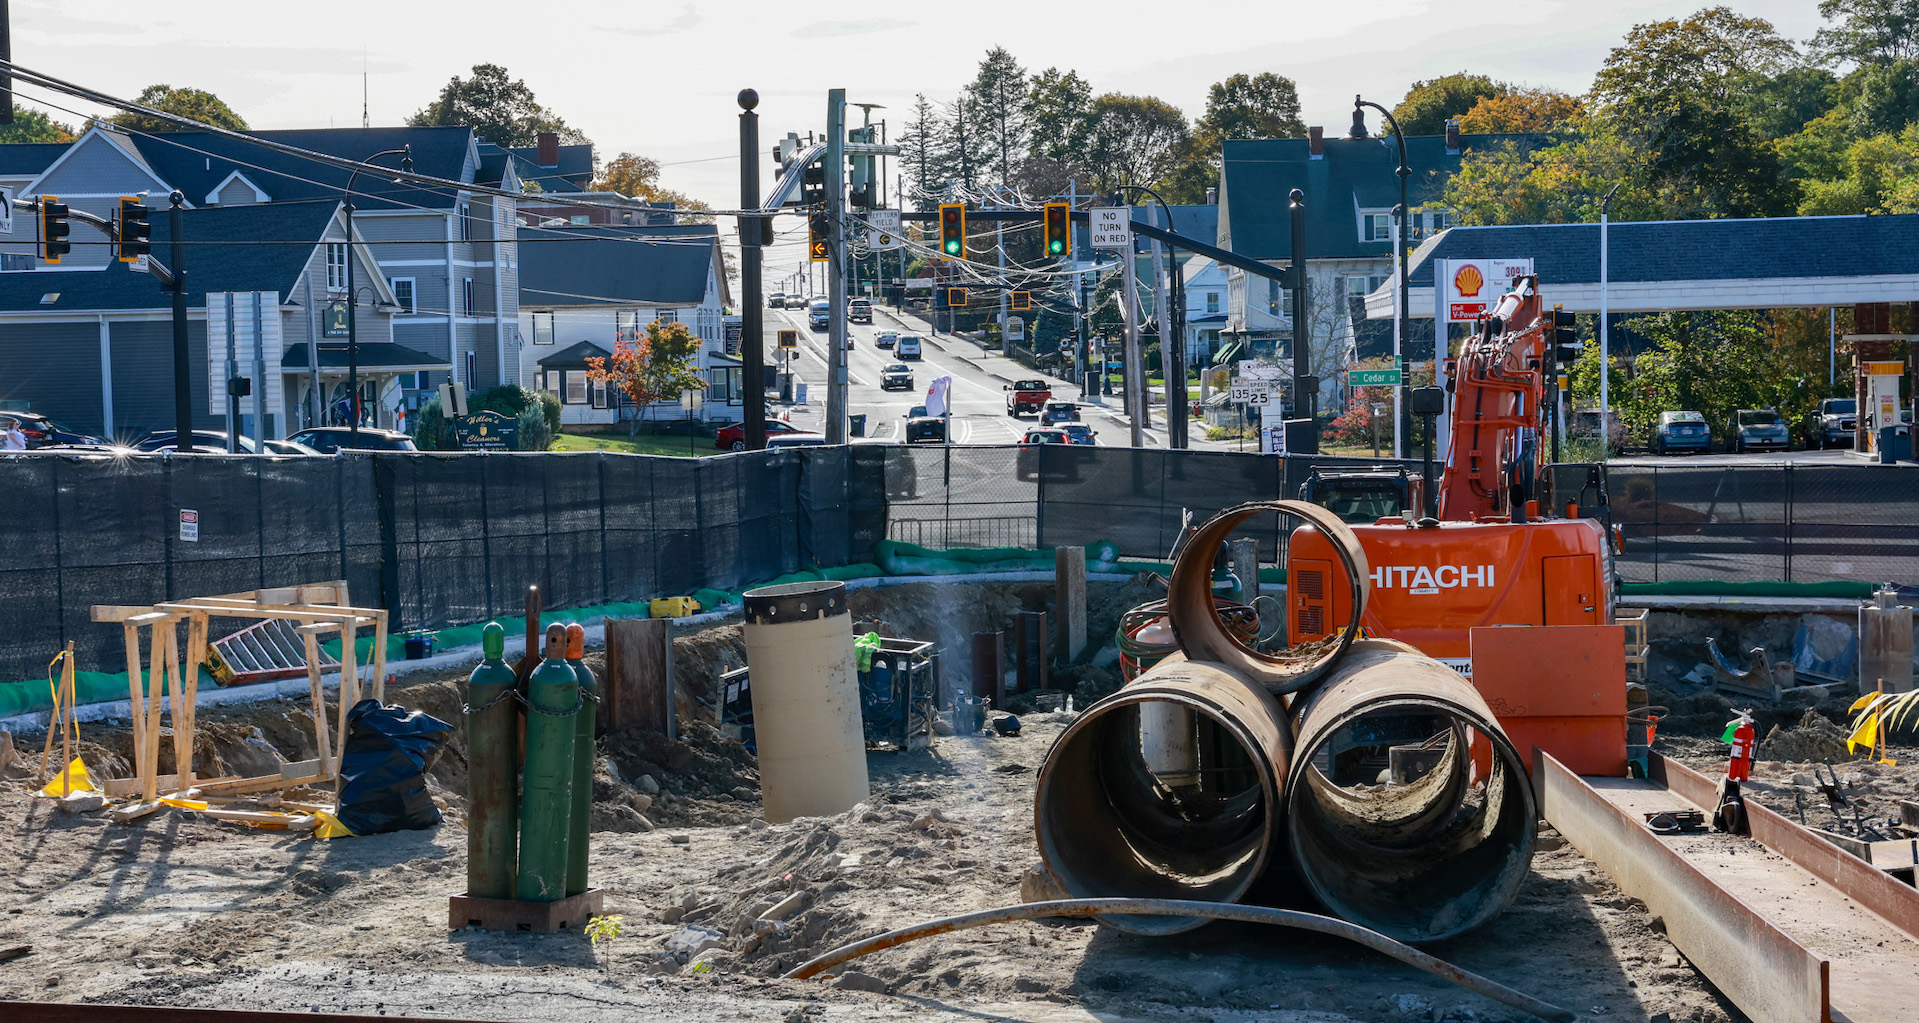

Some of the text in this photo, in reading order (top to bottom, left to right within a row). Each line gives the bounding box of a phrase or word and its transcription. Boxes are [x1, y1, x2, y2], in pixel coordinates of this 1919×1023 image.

[1103, 212, 1117, 220] NO
[1099, 223, 1121, 231] TURN
[1363, 373, 1385, 382] Cedar
[1231, 389, 1249, 400] 135
[1250, 394, 1268, 404] 25
[467, 434, 500, 443] Cleaners
[1369, 565, 1495, 588] HITACHI
